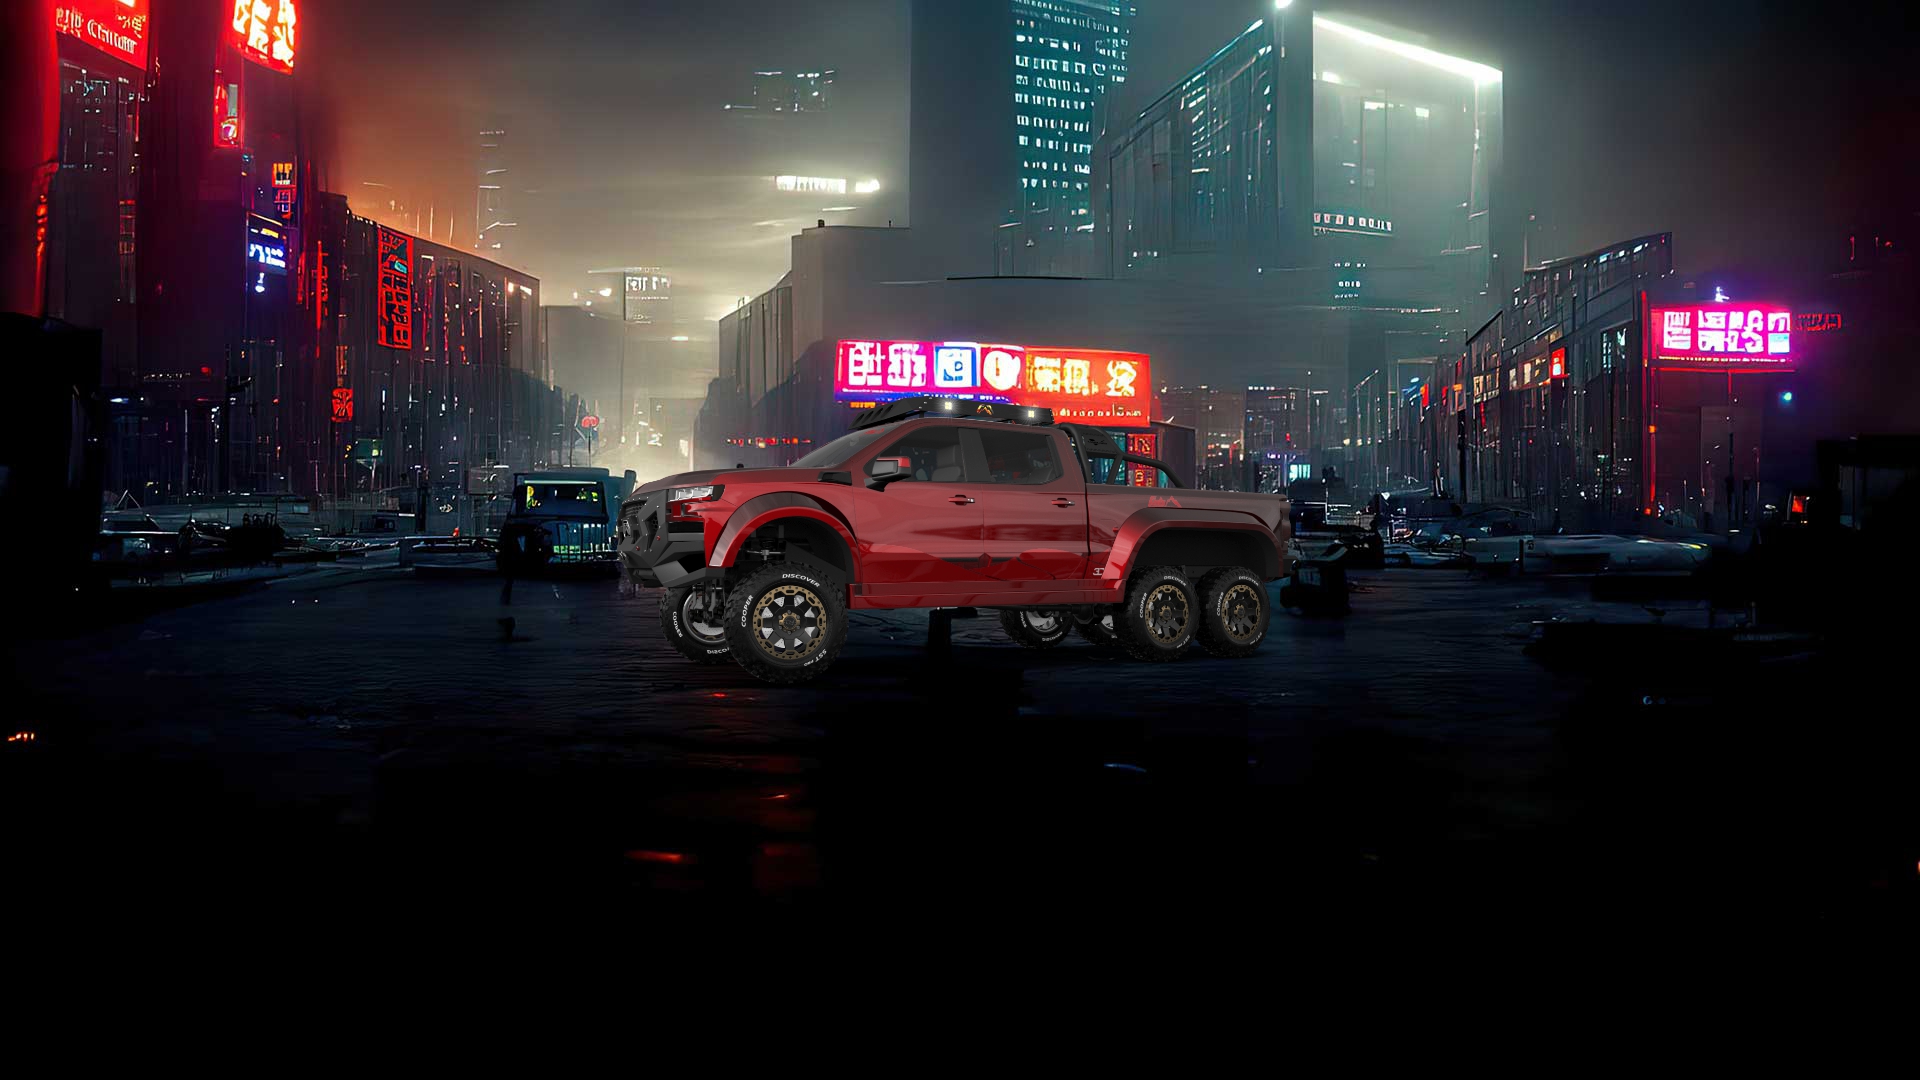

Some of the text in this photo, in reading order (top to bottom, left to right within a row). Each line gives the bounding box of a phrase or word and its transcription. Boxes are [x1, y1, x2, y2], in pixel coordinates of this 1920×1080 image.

[782, 573, 821, 588] DISCOVER
[741, 594, 754, 628] COOPER
[814, 648, 827, 663] SST
